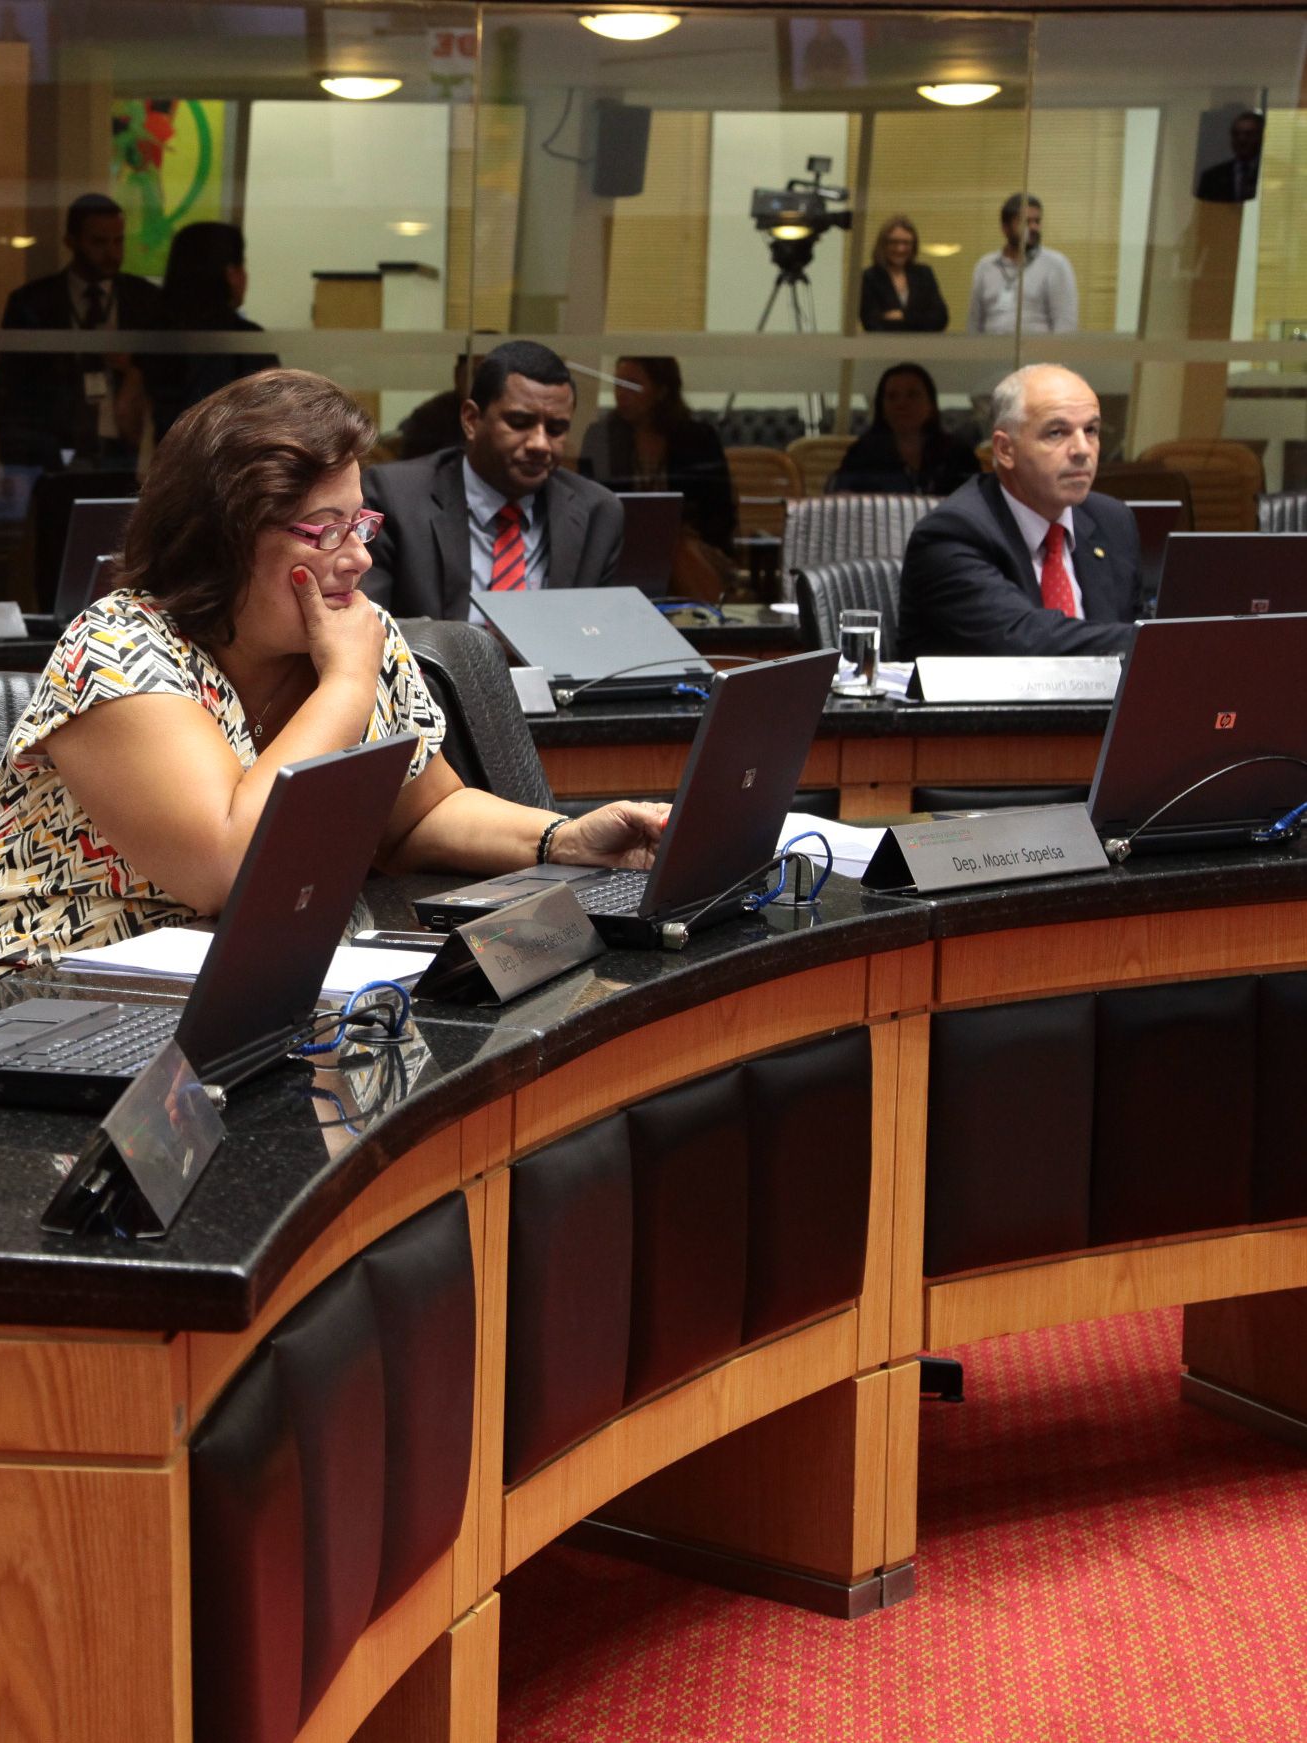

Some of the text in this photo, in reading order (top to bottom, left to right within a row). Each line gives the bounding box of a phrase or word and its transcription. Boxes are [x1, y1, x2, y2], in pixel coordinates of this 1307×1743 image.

[952, 844, 1065, 873] Dep. Moacir Sopelsa
